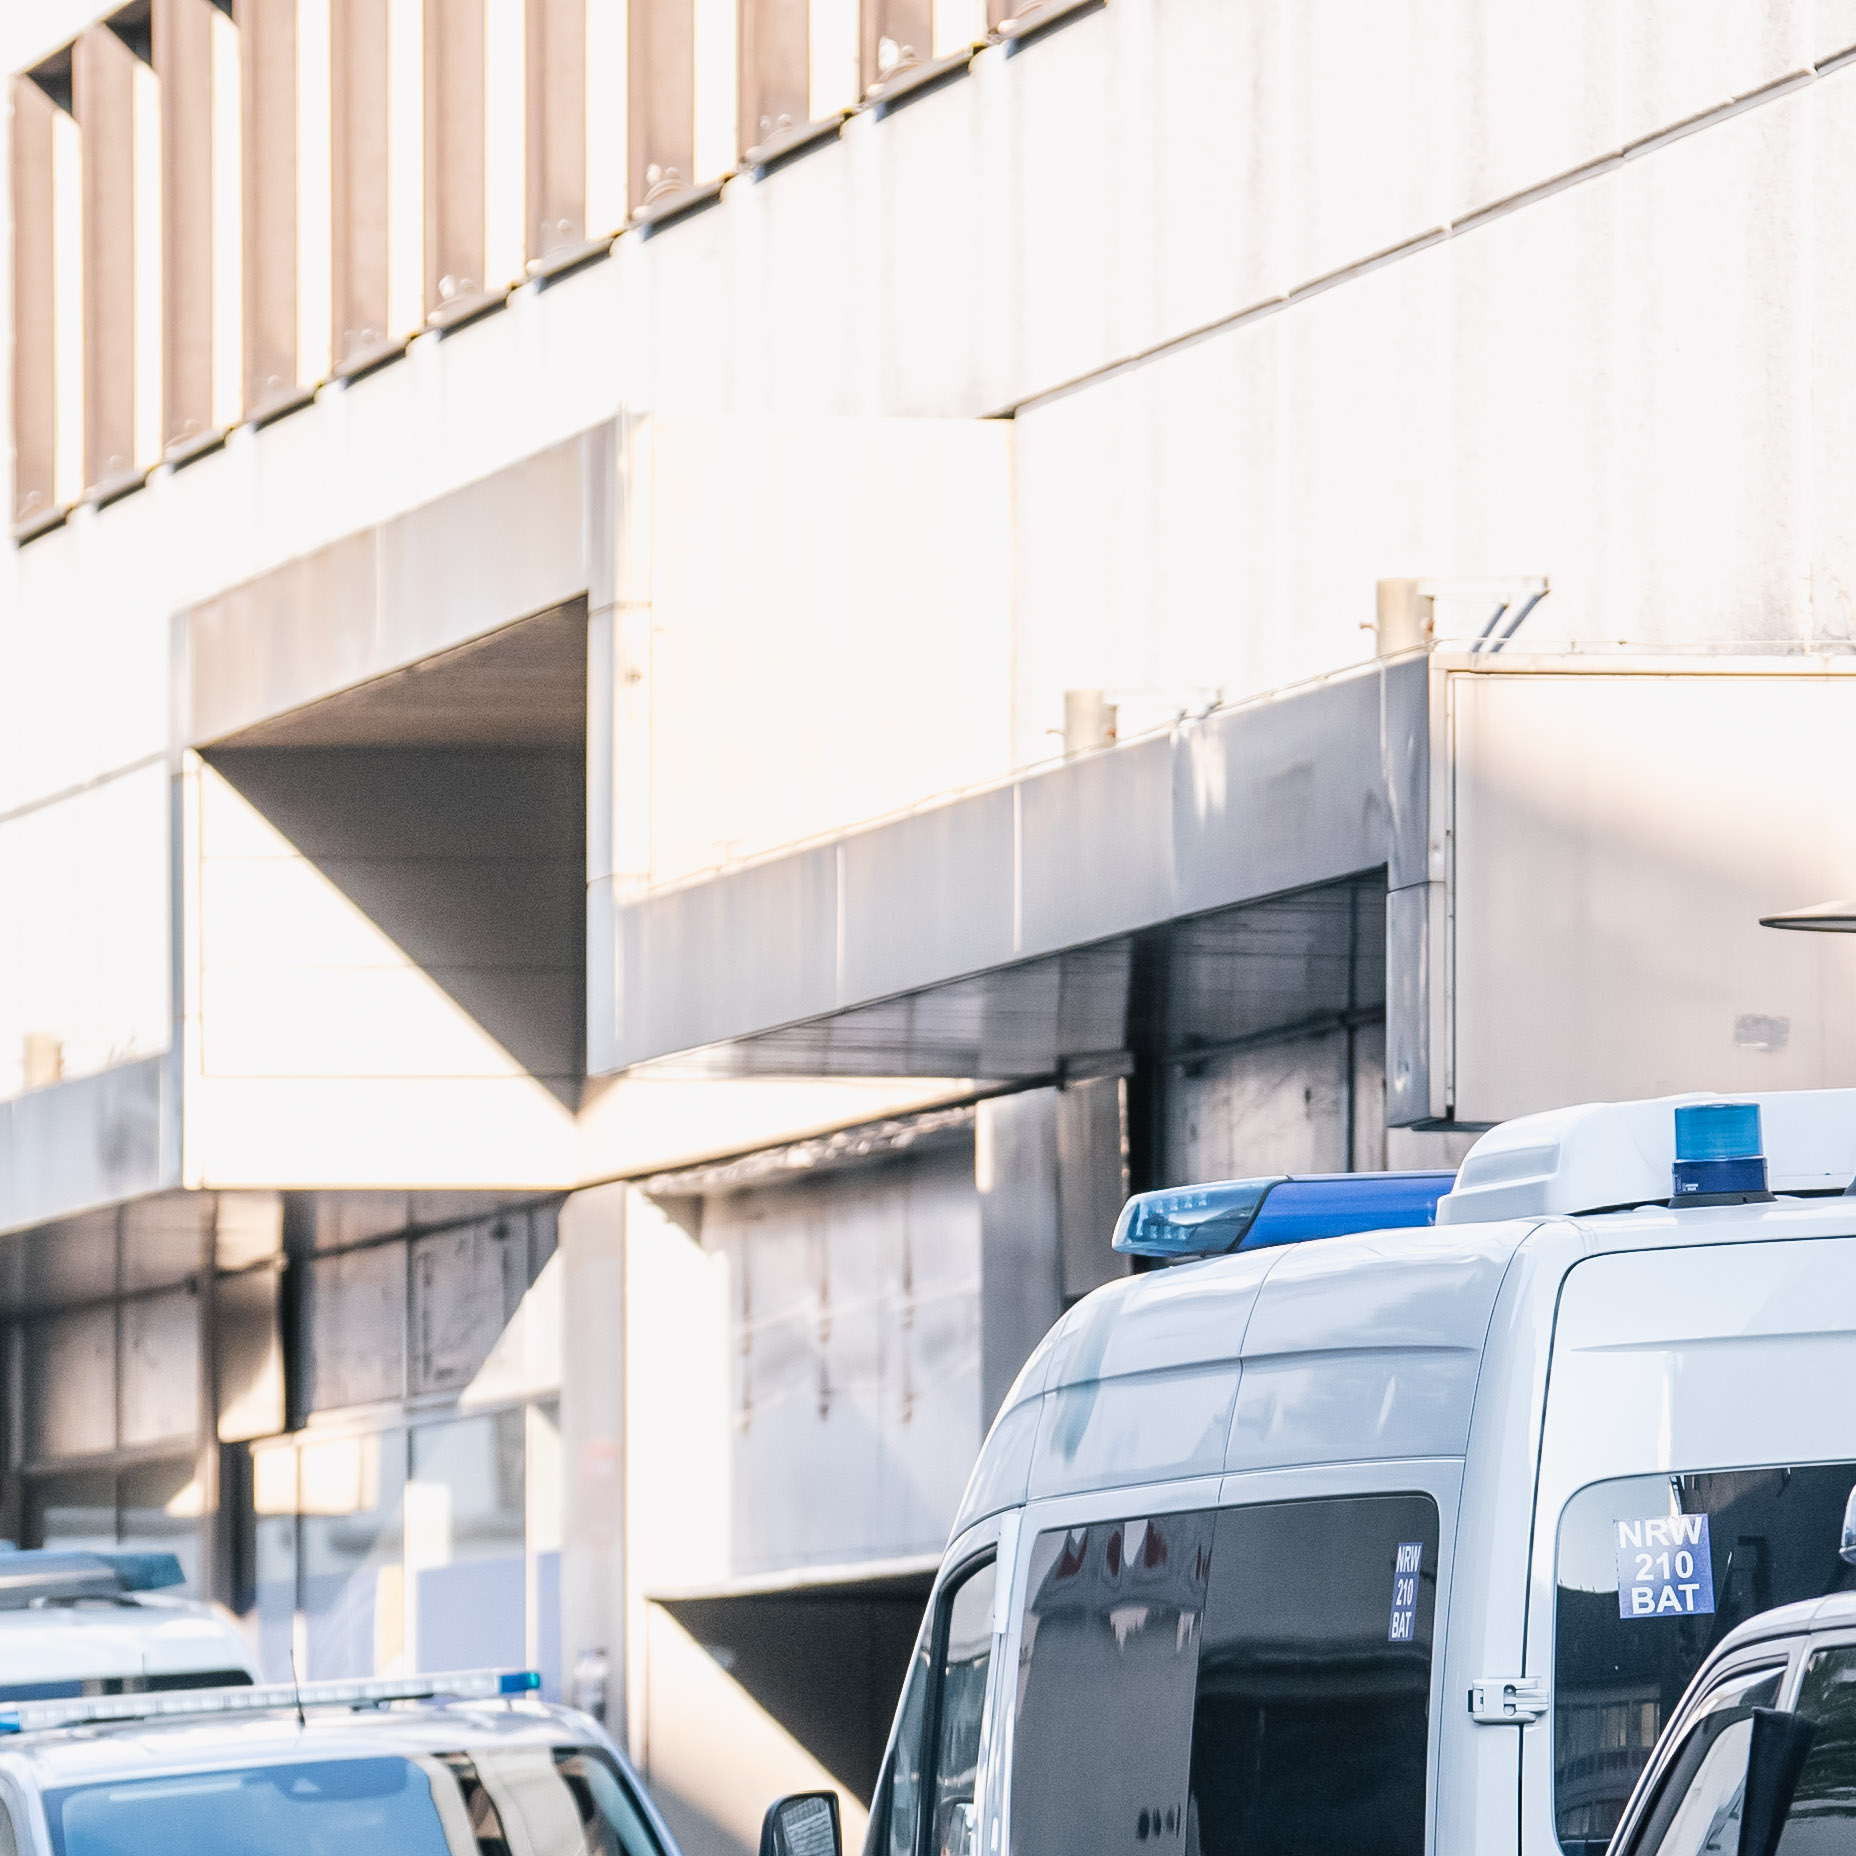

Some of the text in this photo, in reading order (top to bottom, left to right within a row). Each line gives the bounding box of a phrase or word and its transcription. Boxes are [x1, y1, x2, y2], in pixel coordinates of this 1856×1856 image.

[1618, 1516, 1703, 1549] NRW
[1396, 1545, 1422, 1573] NRW
[1634, 1550, 1695, 1581] 210
[1395, 1578, 1414, 1606] 210
[1631, 1583, 1701, 1615] BAT
[1391, 1611, 1413, 1639] BAT
